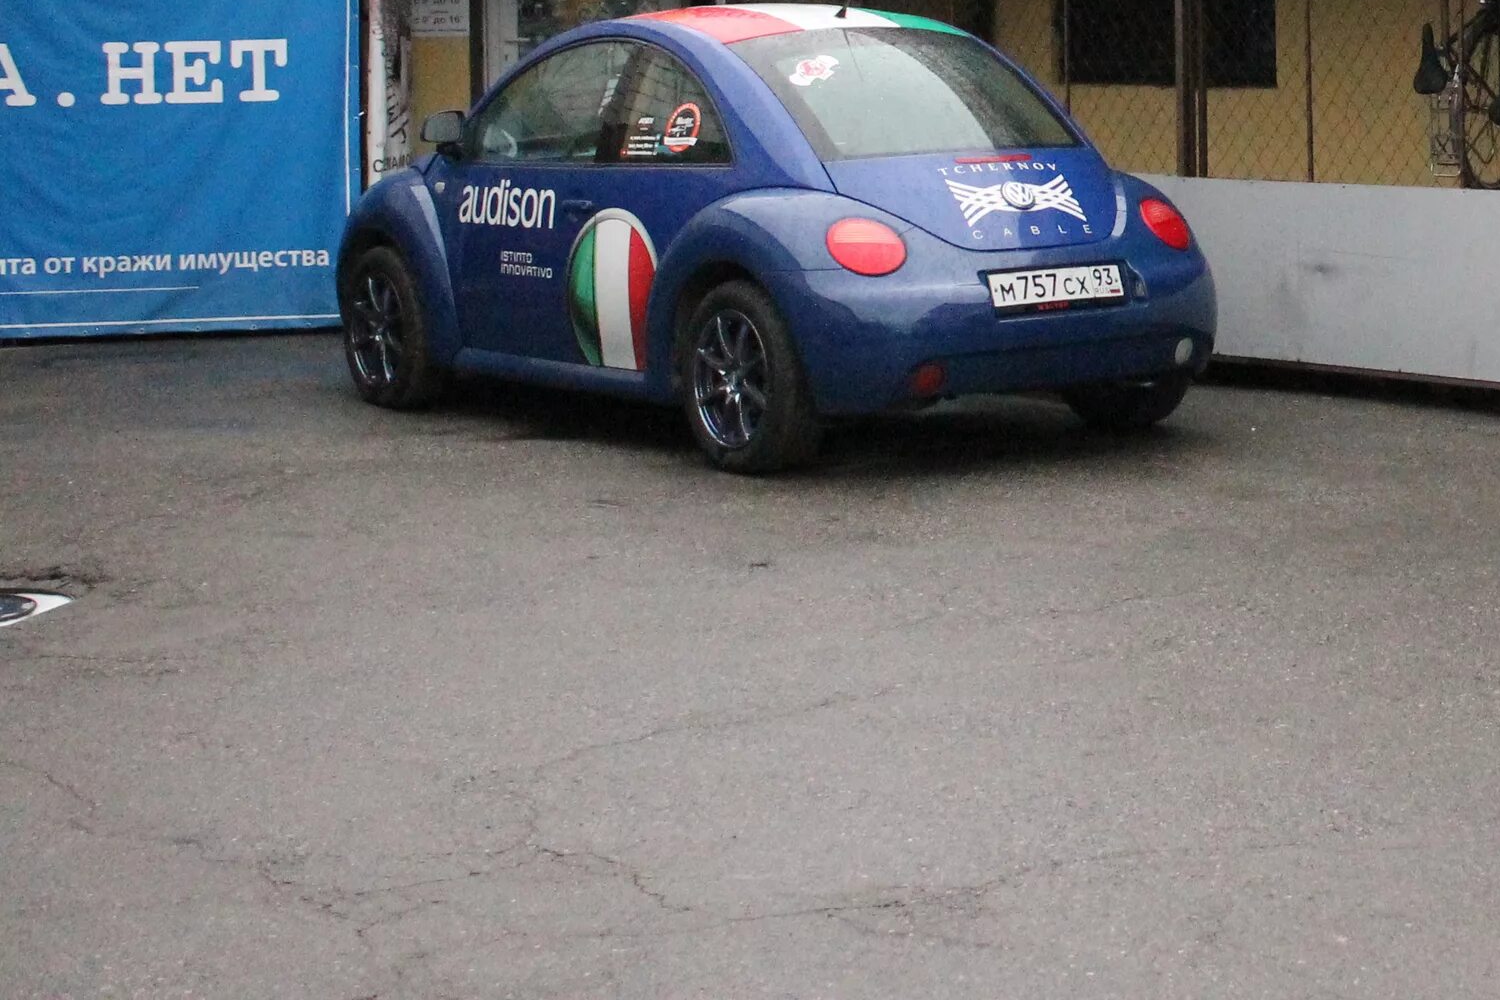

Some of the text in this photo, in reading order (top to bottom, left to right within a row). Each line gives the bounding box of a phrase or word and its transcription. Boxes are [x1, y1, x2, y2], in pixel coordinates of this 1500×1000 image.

[938, 162, 1057, 177] TCHERNOV
[459, 179, 556, 229] audison
[0, 248, 330, 278] та от кражи имущества
[1092, 268, 1113, 286] 93
